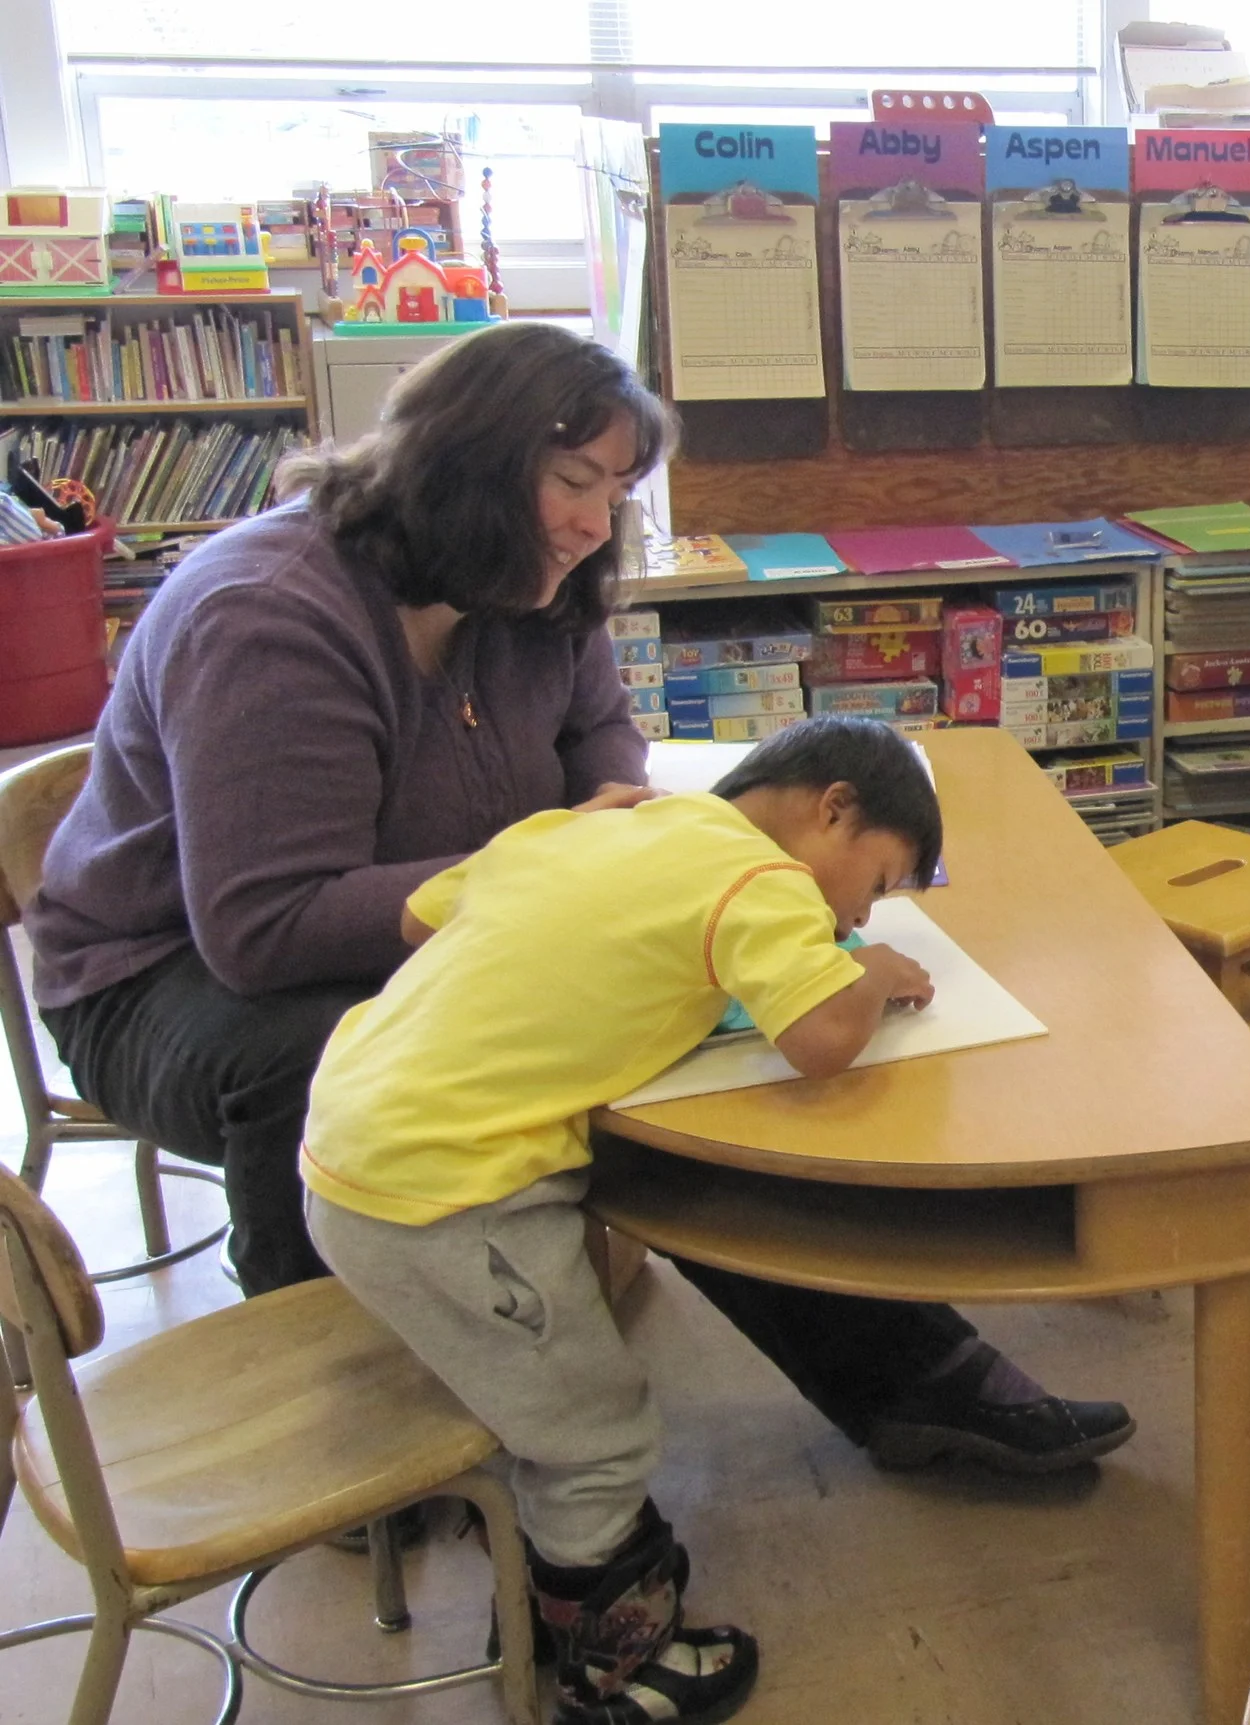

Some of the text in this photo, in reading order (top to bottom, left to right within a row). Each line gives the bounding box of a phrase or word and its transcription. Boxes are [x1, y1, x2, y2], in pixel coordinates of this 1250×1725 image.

[694, 130, 775, 160] Colin
[858, 127, 942, 164] Abby
[1005, 131, 1100, 165] Aspen
[833, 607, 854, 622] 63
[1013, 592, 1037, 615] 24
[1014, 619, 1047, 640] 60
